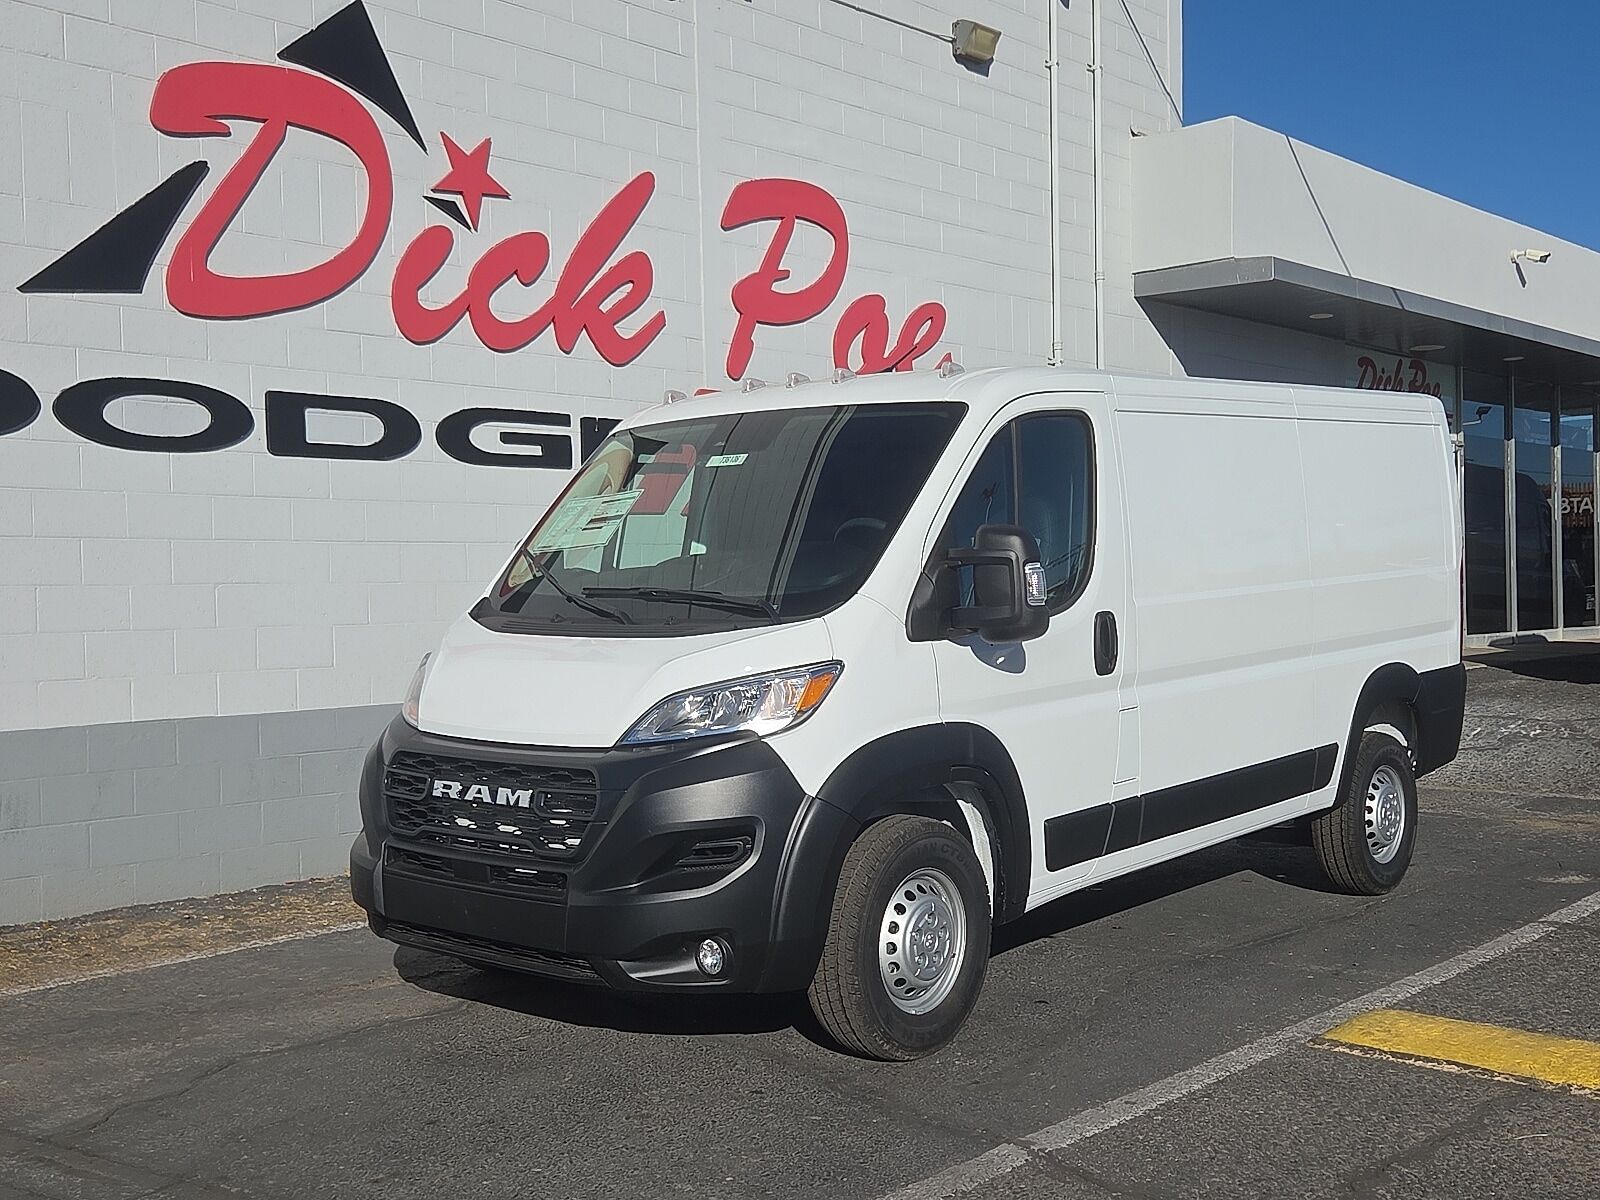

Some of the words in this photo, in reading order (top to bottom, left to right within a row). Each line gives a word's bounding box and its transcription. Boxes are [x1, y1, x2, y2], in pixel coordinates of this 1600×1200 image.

[149, 61, 667, 366] Dick
[720, 177, 953, 381] Poe
[1357, 356, 1404, 390] Dick
[0, 369, 624, 471] ODG
[432, 780, 533, 808] RAM
